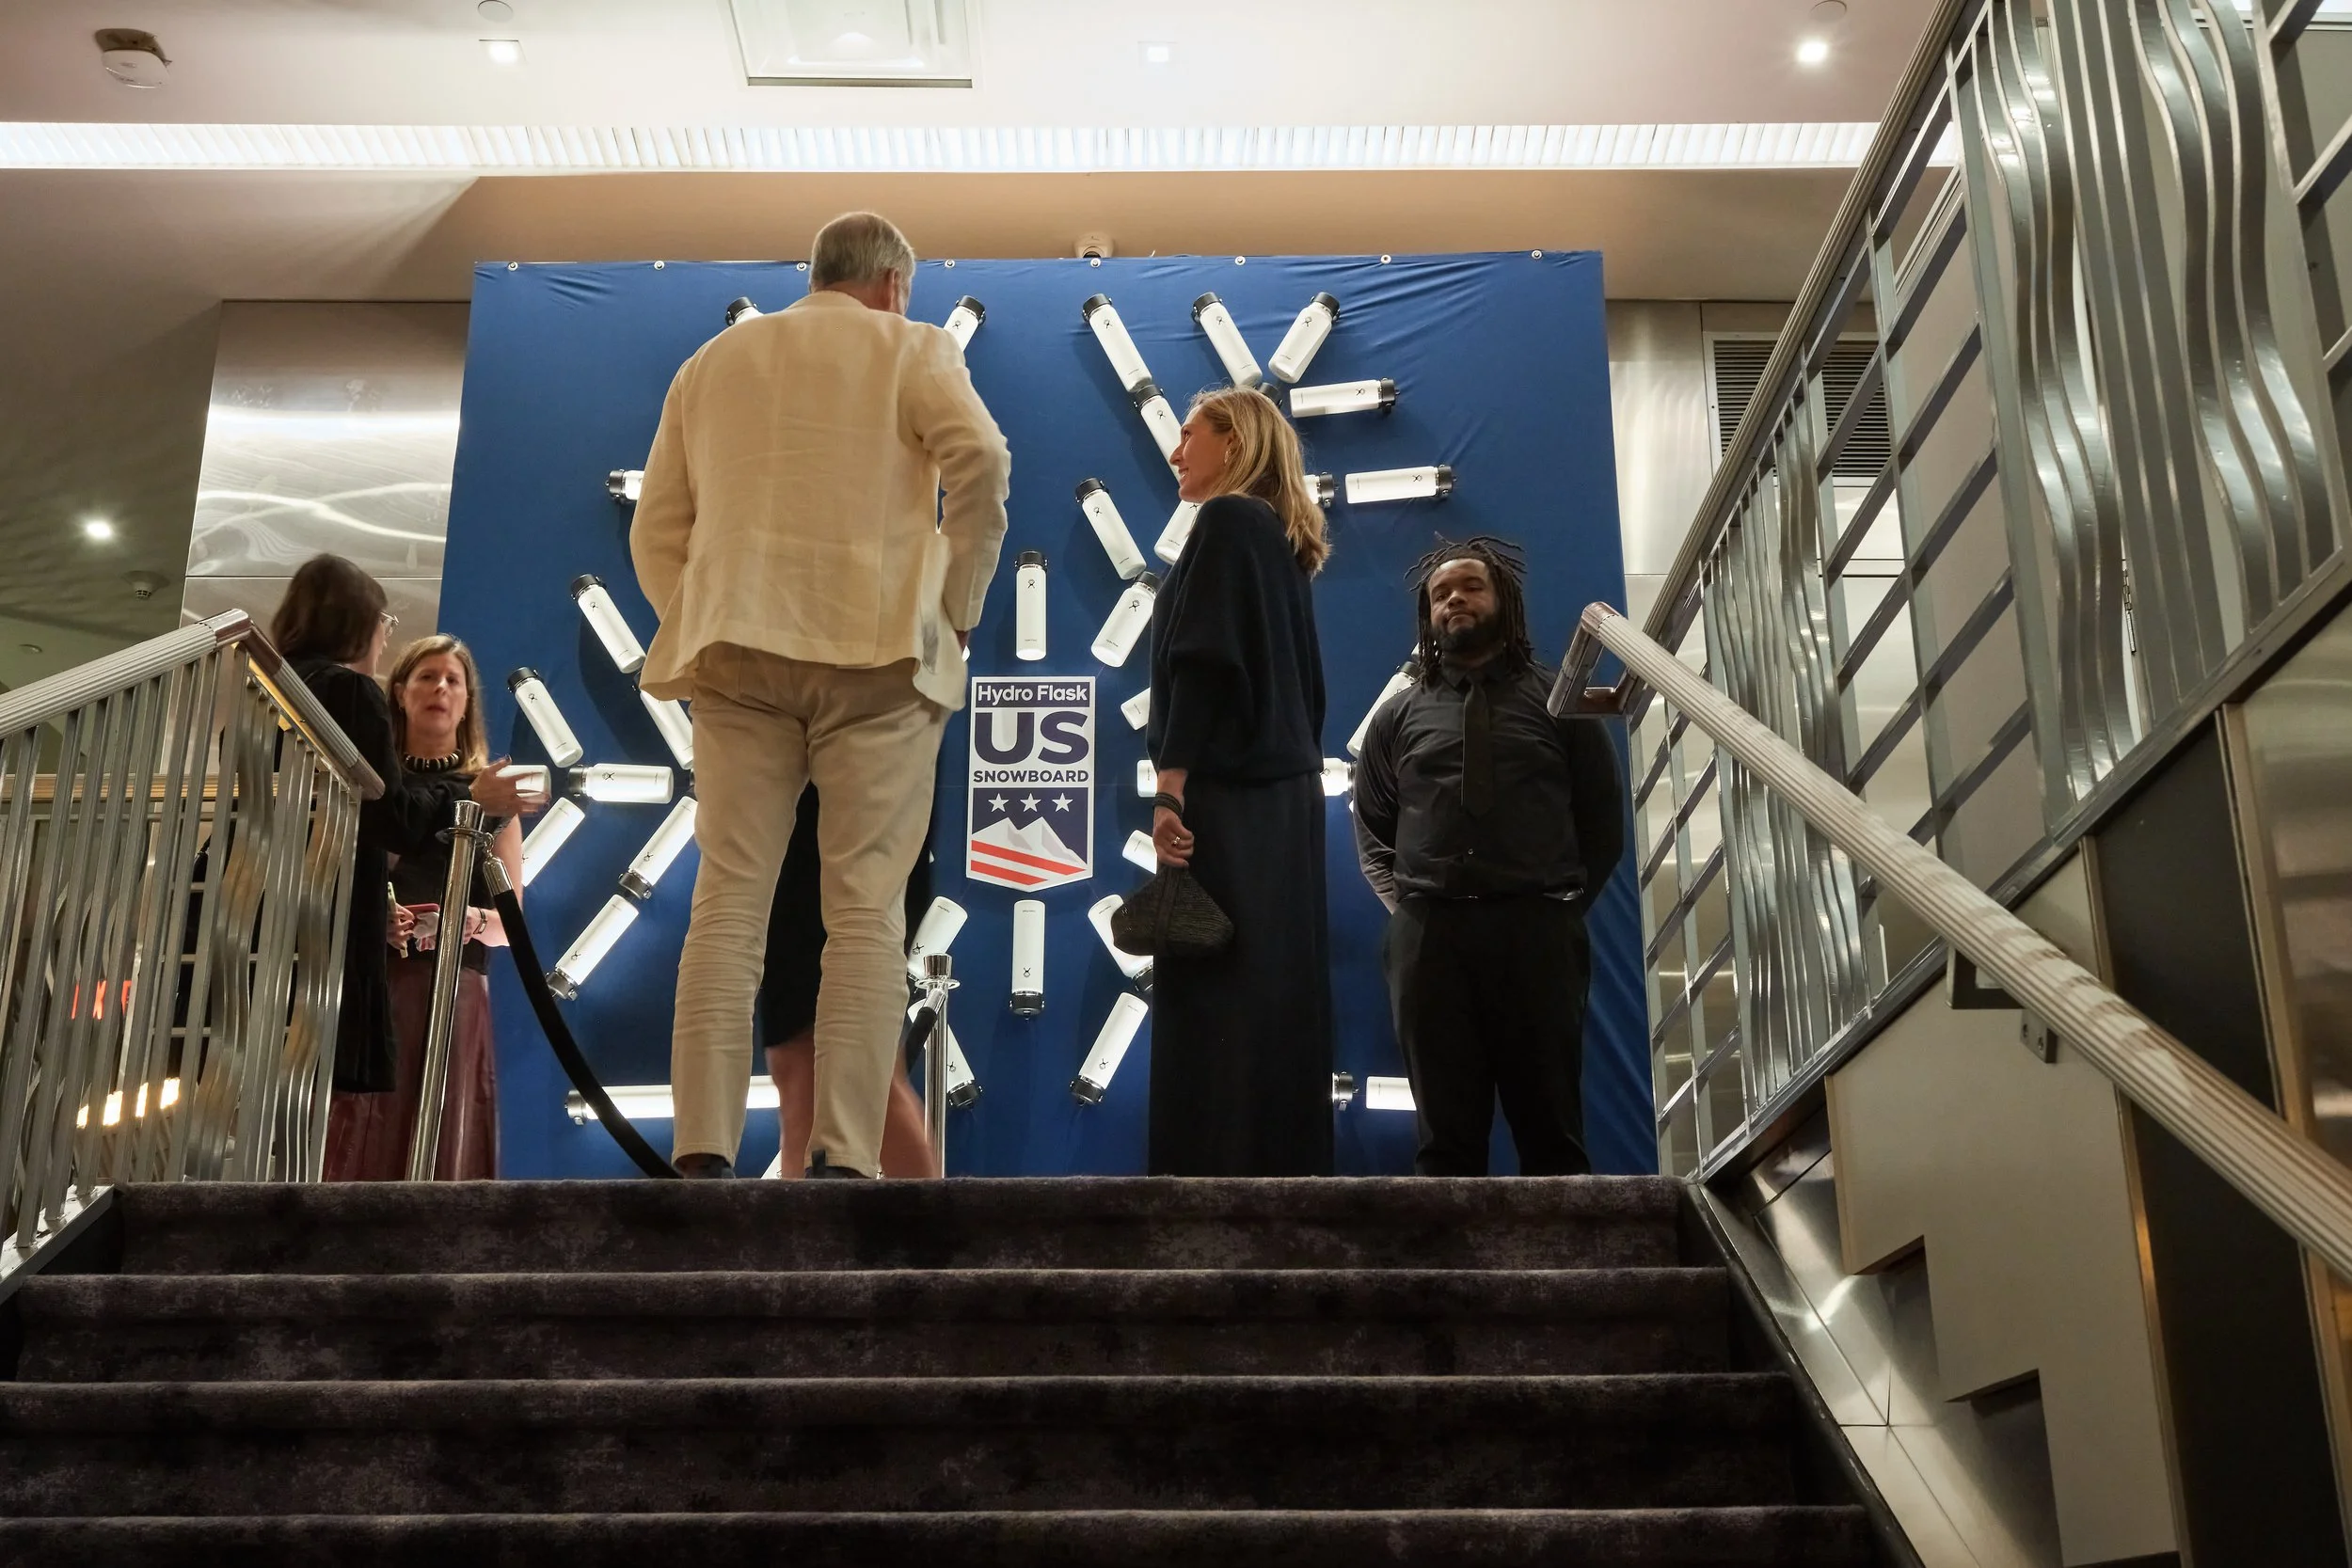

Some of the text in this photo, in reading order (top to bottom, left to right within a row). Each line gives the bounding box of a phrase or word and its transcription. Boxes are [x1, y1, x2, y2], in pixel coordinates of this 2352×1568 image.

[977, 685, 1088, 705] Hydro Flask
[975, 711, 1089, 765] US
[973, 770, 1089, 783] SNOWBOARD
